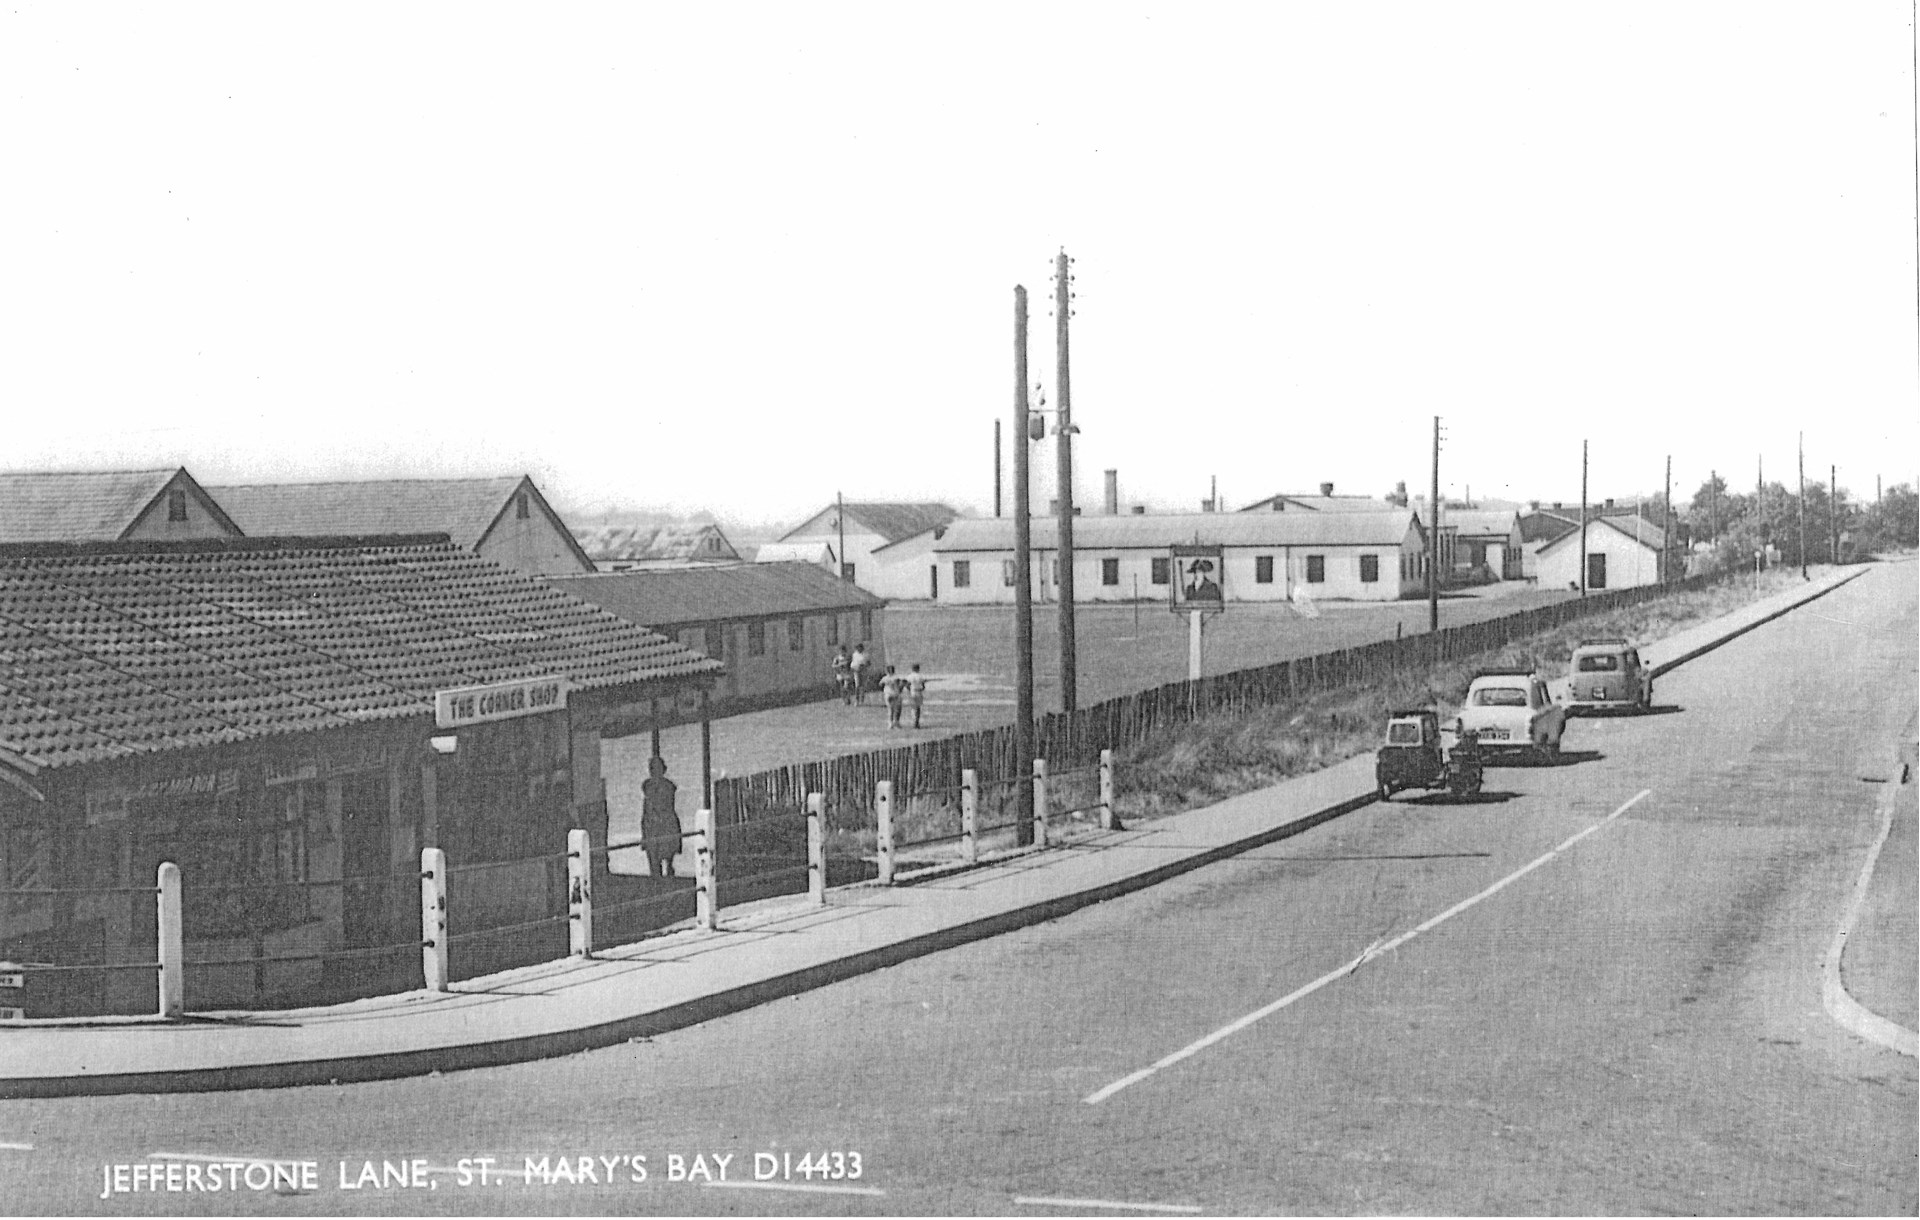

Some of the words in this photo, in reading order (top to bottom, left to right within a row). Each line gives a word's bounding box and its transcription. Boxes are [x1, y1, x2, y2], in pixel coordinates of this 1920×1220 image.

[450, 695, 475, 719] THE
[479, 687, 525, 715] CORNER
[530, 683, 559, 707] SHOP
